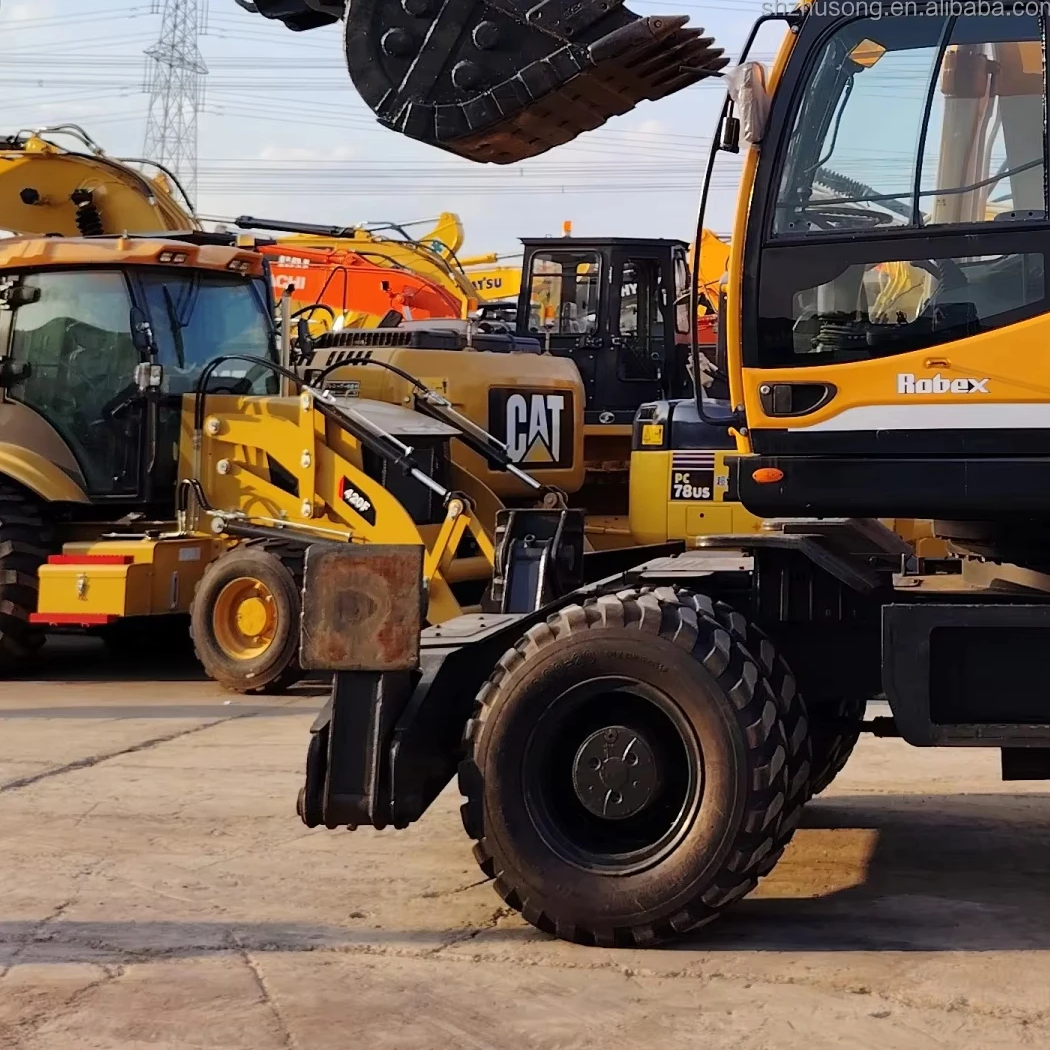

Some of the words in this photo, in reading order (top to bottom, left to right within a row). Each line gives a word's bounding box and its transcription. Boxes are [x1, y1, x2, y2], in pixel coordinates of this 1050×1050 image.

[897, 373, 991, 394] Robex
[506, 394, 564, 463] CAT
[674, 472, 691, 484] PC
[343, 488, 371, 512] 420F
[673, 484, 711, 499] 78US
